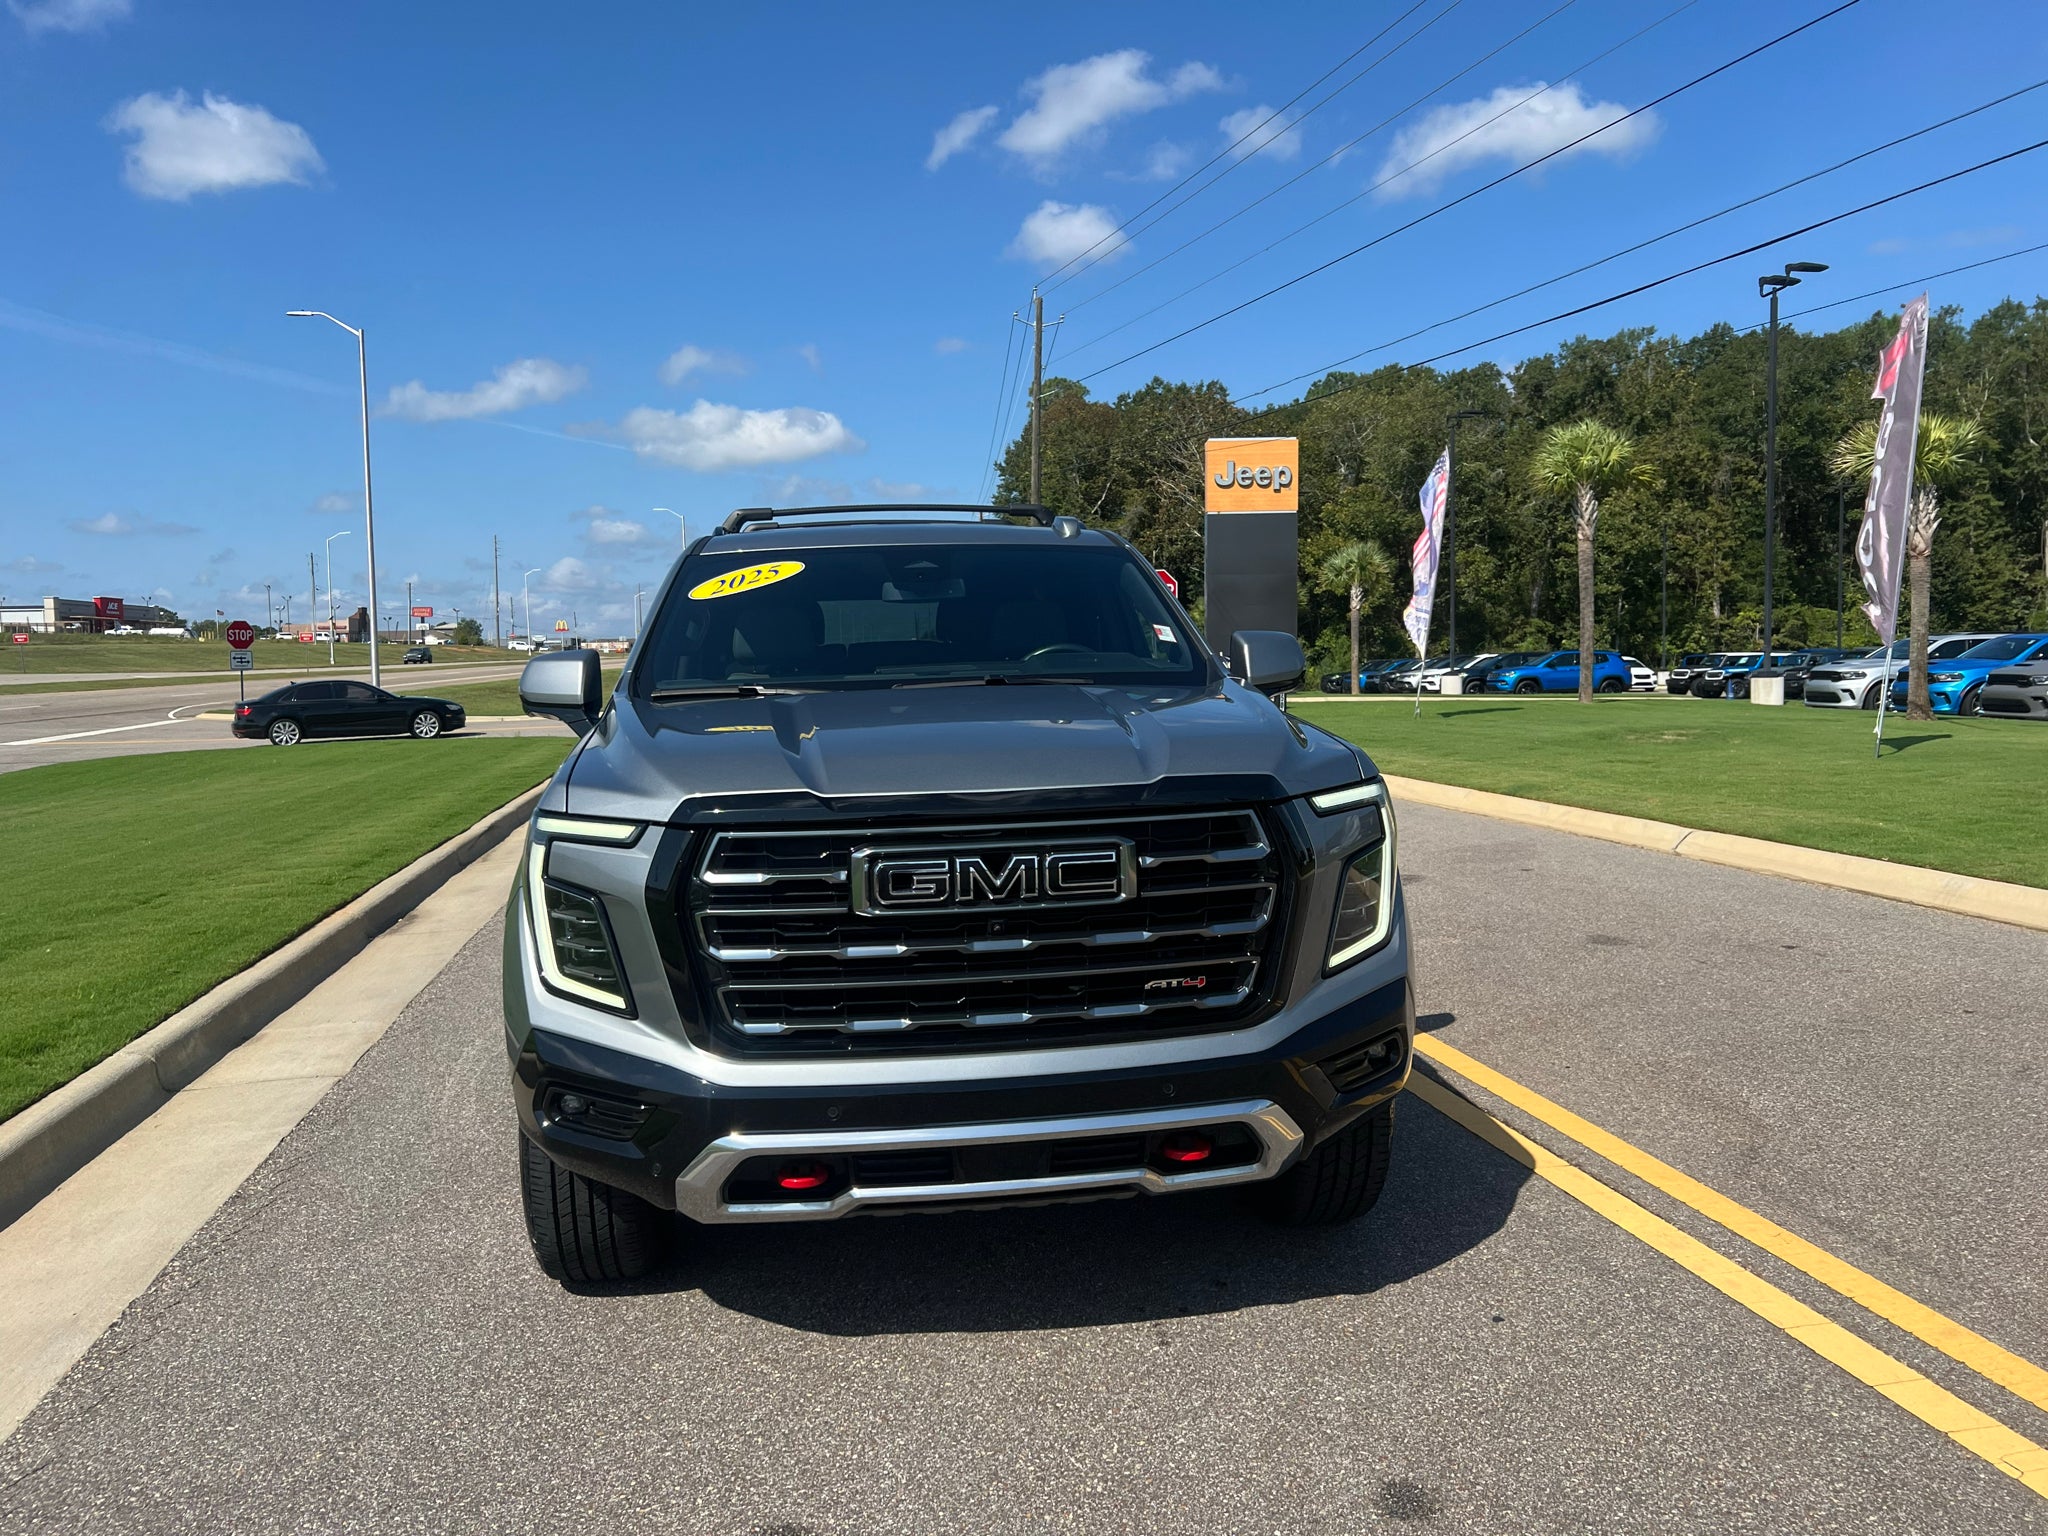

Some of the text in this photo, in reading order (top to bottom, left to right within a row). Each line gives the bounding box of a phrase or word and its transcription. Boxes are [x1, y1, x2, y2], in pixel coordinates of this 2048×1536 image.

[1214, 461, 1292, 493] Jeep
[711, 564, 782, 595] 2025
[107, 601, 119, 610] ACE
[228, 629, 253, 641] STOP
[874, 851, 1117, 904] GMC
[1144, 975, 1206, 990] AT4
